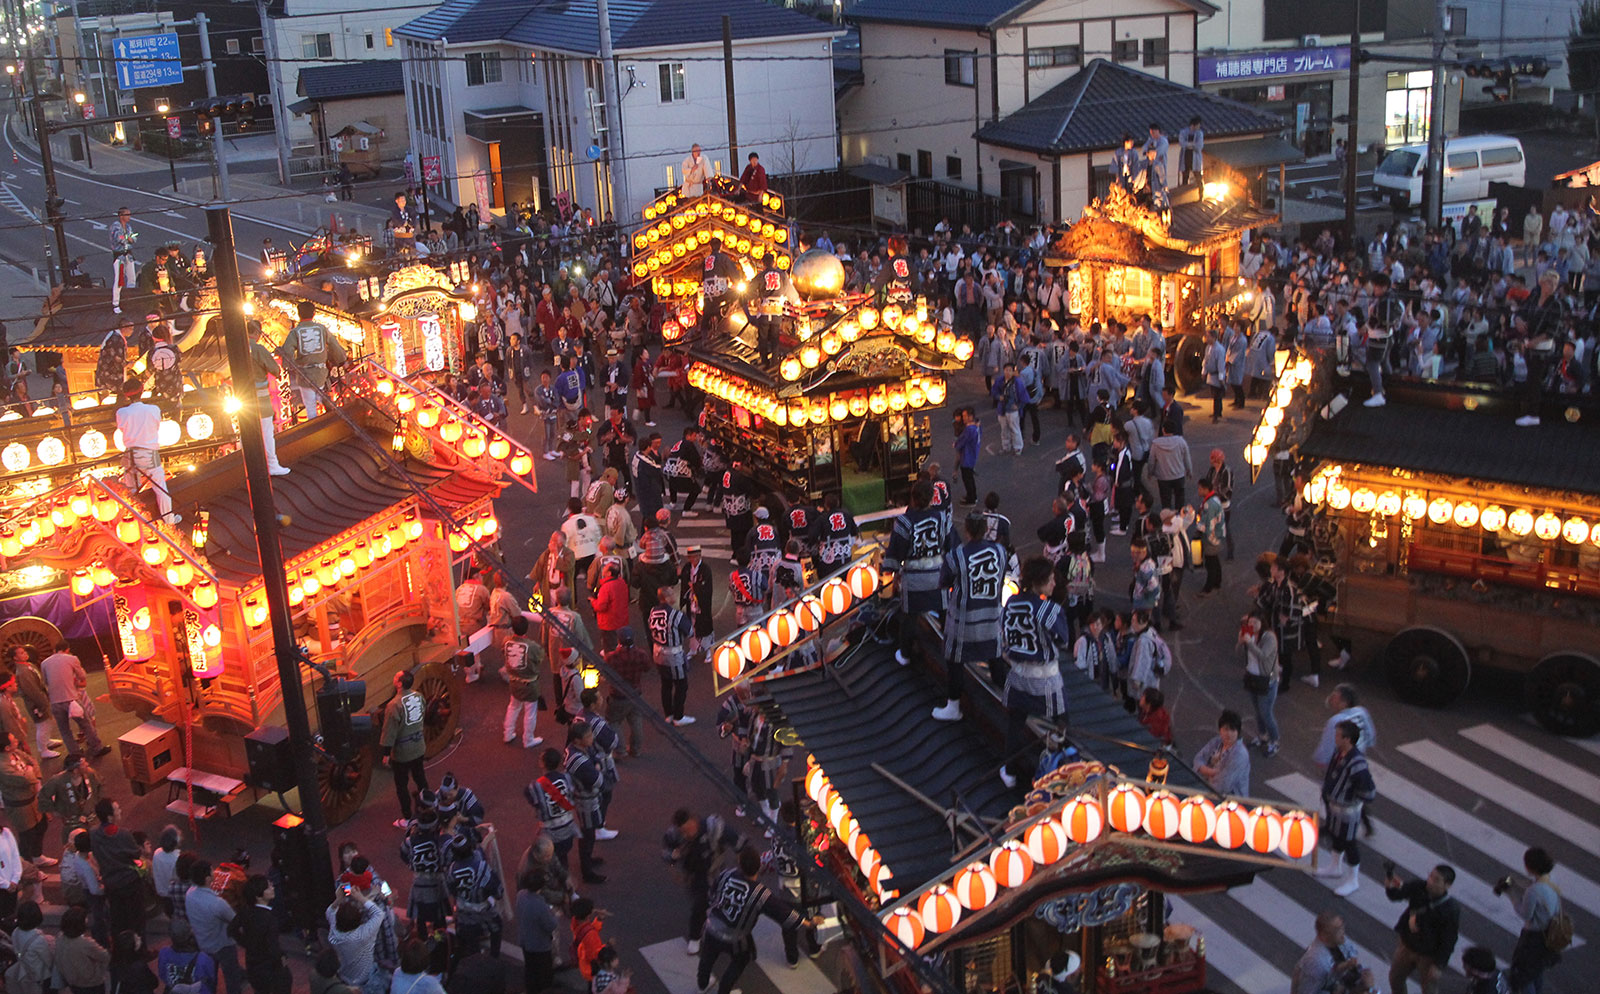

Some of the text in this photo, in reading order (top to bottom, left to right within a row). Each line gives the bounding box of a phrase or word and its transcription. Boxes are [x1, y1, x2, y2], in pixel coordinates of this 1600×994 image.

[1215, 54, 1334, 78] 補聴器専門店 ブルーム
[790, 508, 807, 528] 荒
[829, 512, 846, 532] 荒
[757, 524, 775, 541] 荒
[968, 547, 1000, 600] 元町
[649, 606, 669, 645] 元町
[1004, 601, 1038, 655] 元町
